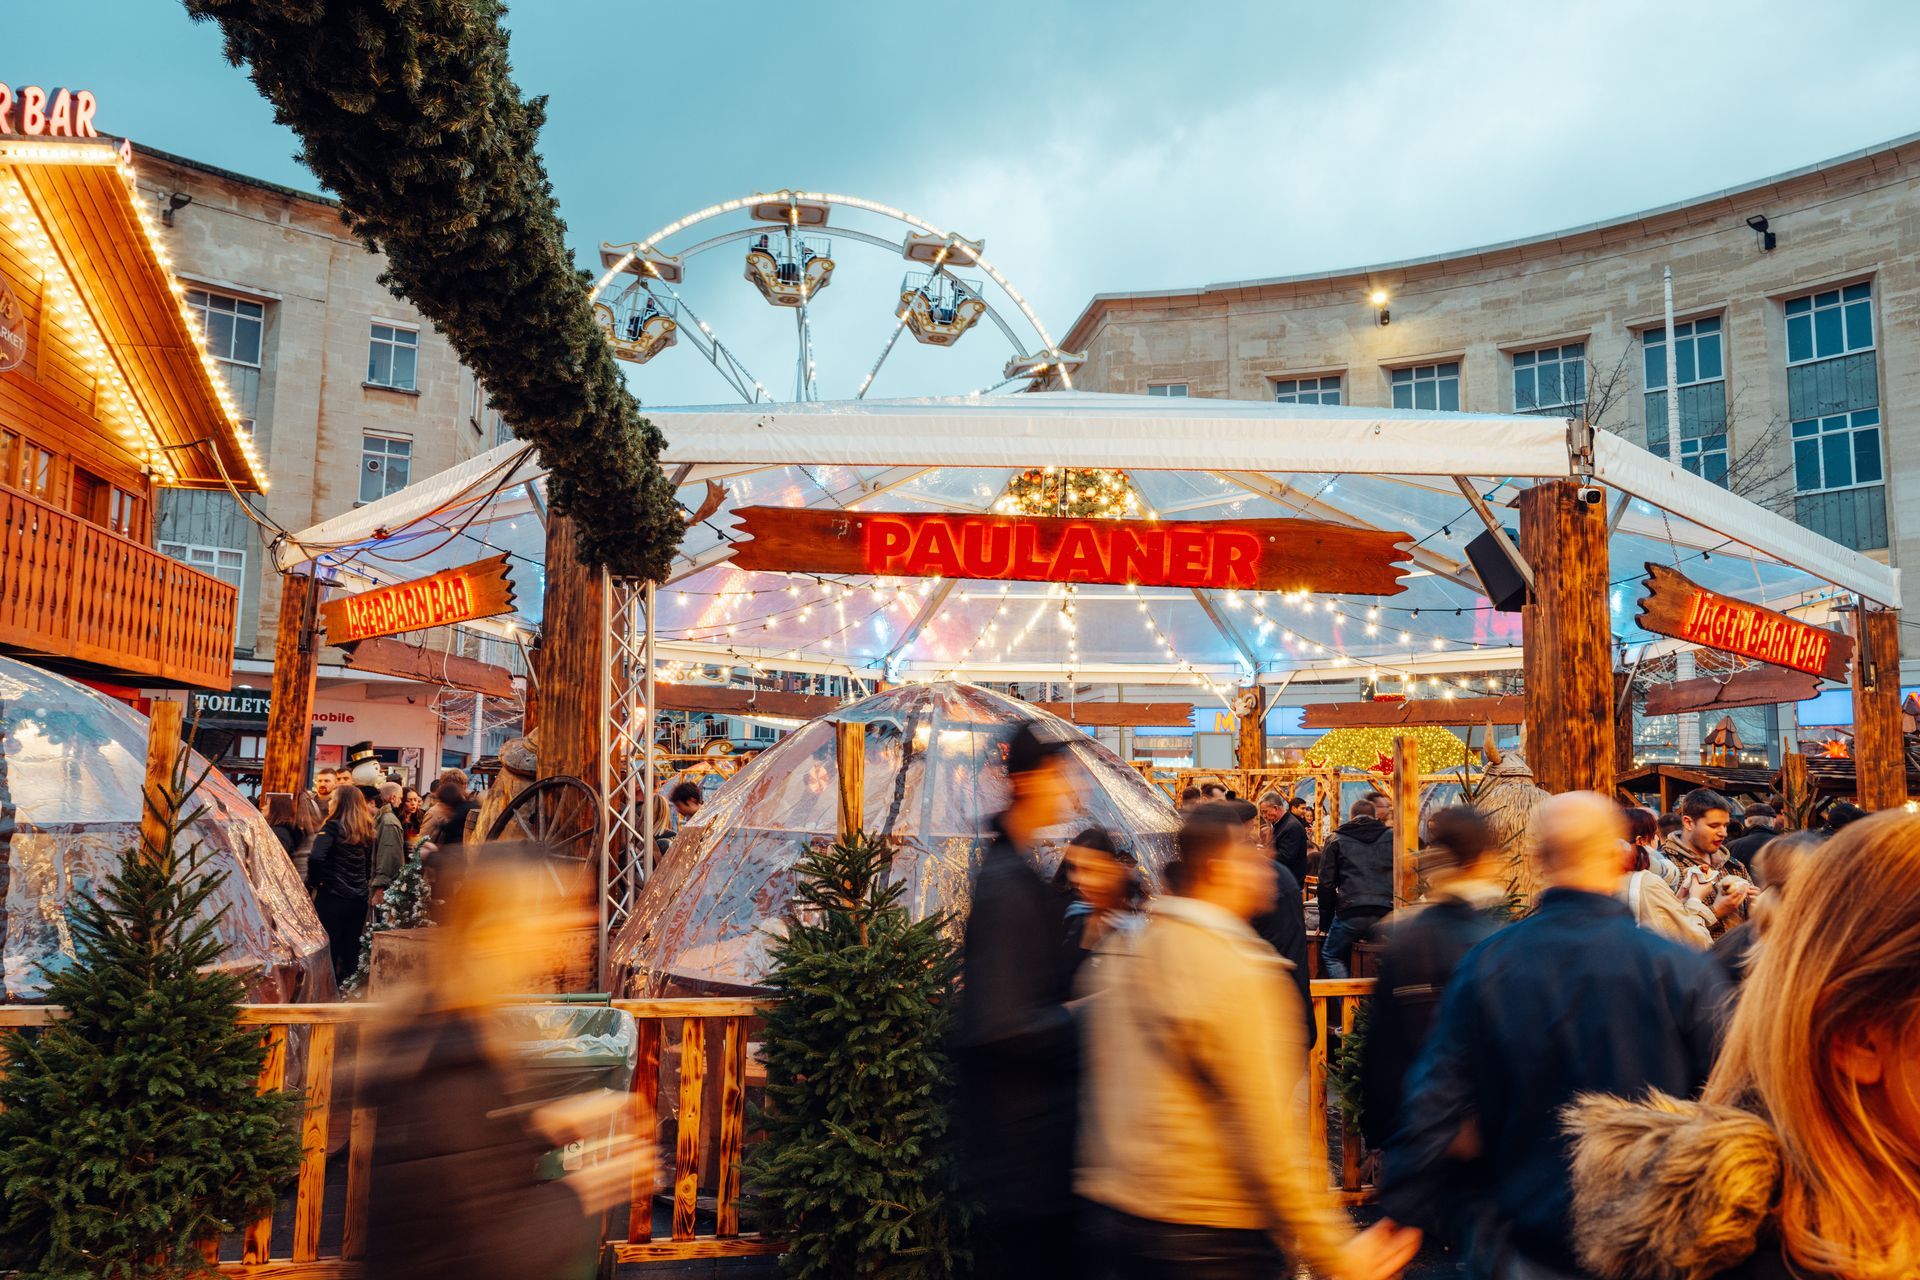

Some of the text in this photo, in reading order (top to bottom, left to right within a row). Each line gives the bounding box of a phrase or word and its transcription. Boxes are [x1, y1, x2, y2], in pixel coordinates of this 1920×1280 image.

[23, 86, 98, 138] BAR
[0, 325, 24, 350] RKET
[868, 520, 1260, 585] PAULANER
[428, 577, 471, 623] BAR
[1796, 626, 1831, 674] BAR
[195, 694, 271, 714] TOILETS
